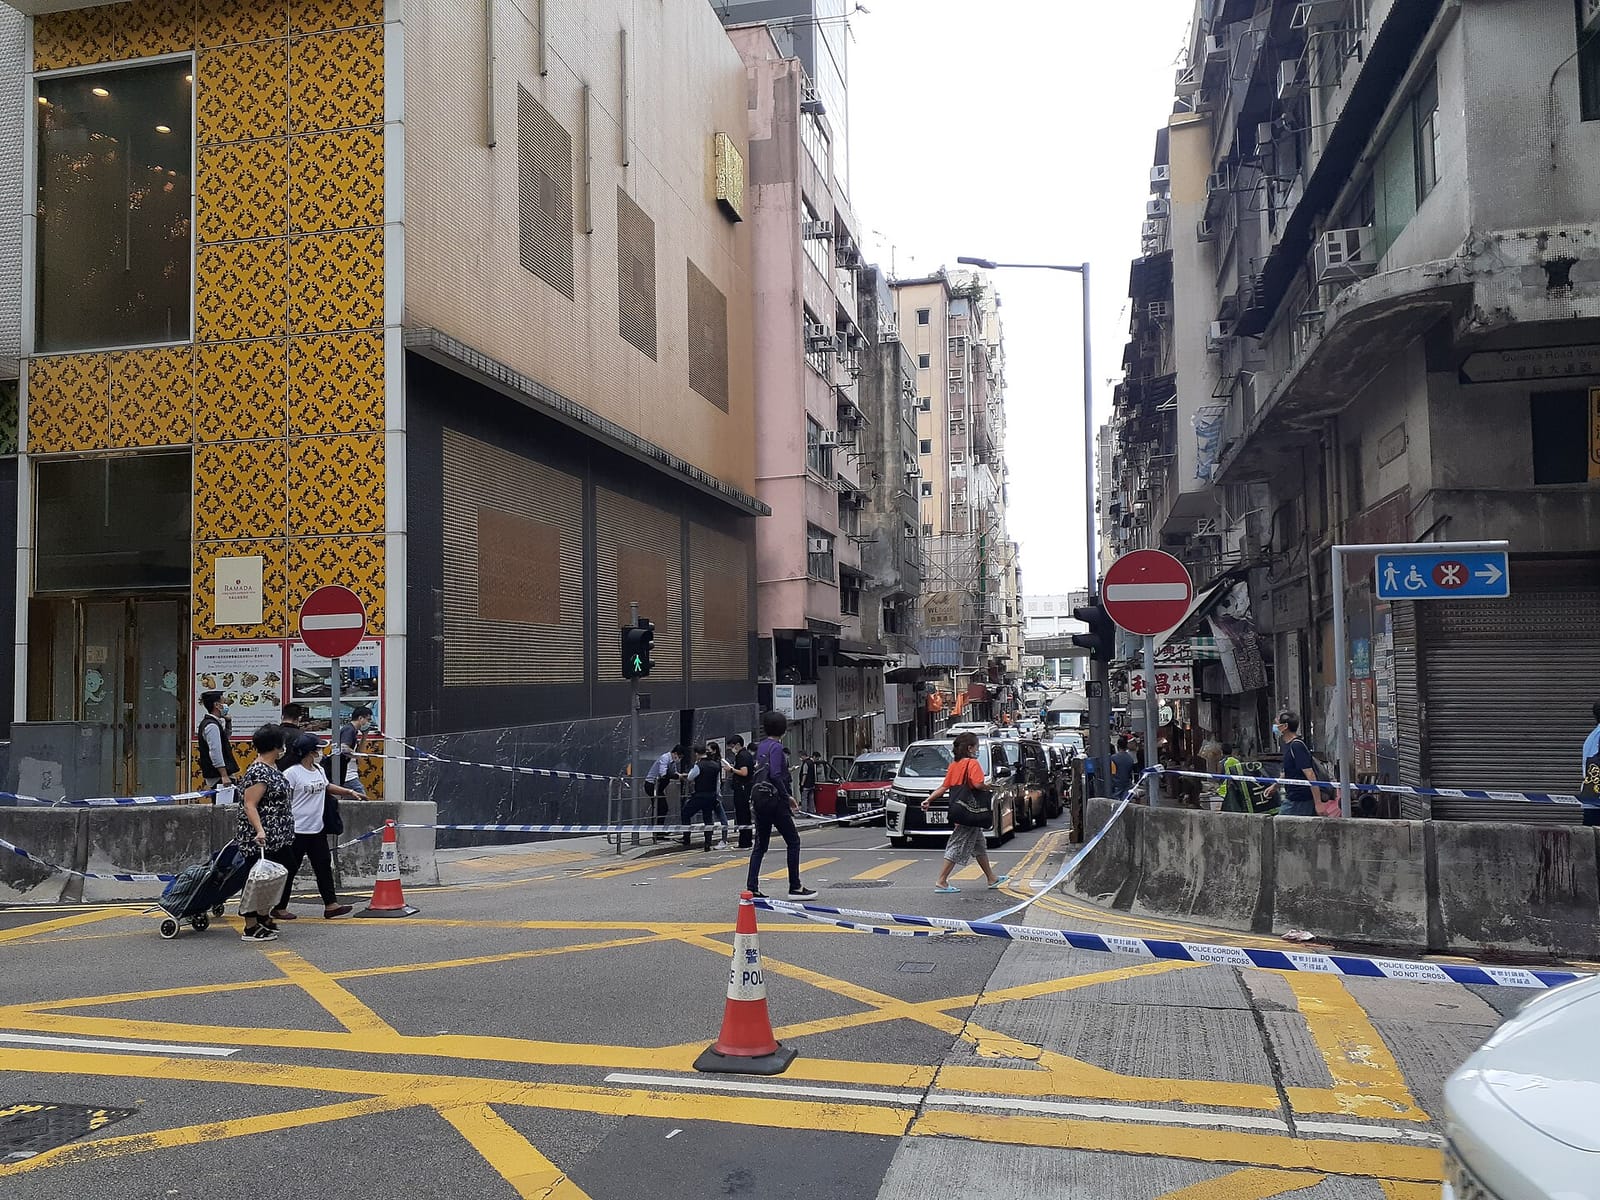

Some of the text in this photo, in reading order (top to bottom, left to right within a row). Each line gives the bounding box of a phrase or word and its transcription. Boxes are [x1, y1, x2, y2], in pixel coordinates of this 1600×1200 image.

[1009, 926, 1031, 936] POLICE
[1045, 938, 1067, 946] CROSS
[1188, 945, 1212, 954] POLICE
[1200, 954, 1250, 965] DO NOT CROSS
[1378, 961, 1404, 970] POLICE
[1421, 972, 1446, 980] CROSS
